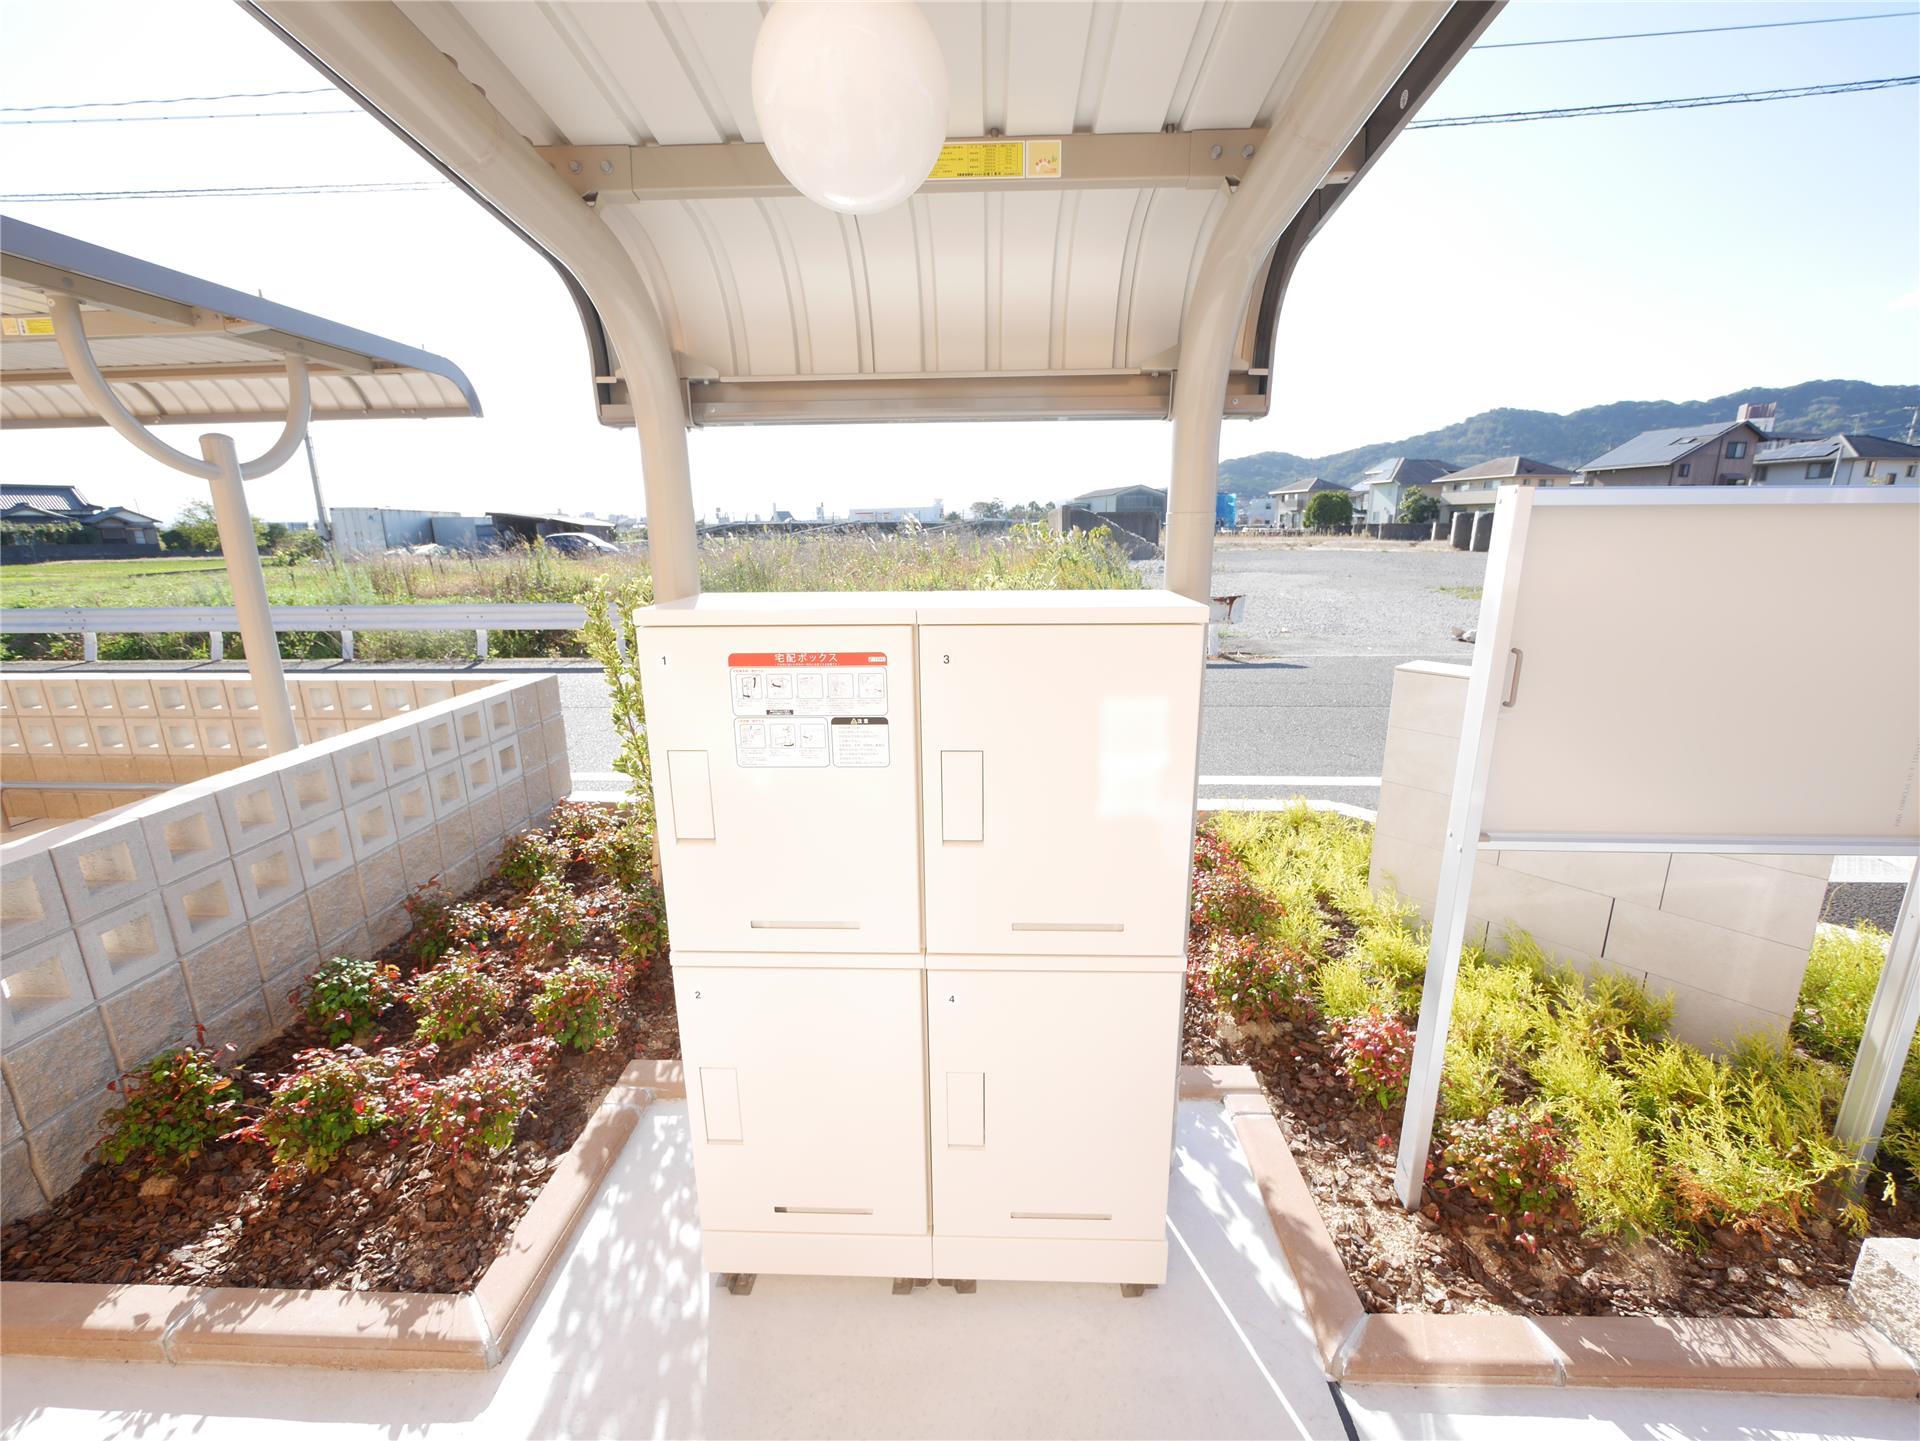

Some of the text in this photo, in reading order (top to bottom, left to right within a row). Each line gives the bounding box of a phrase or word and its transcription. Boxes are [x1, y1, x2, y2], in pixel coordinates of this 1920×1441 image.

[661, 655, 666, 665] 1
[774, 653, 838, 663] 宅配ボックス
[943, 655, 950, 665] 3
[694, 990, 701, 999] 2
[948, 995, 955, 1003] 4
